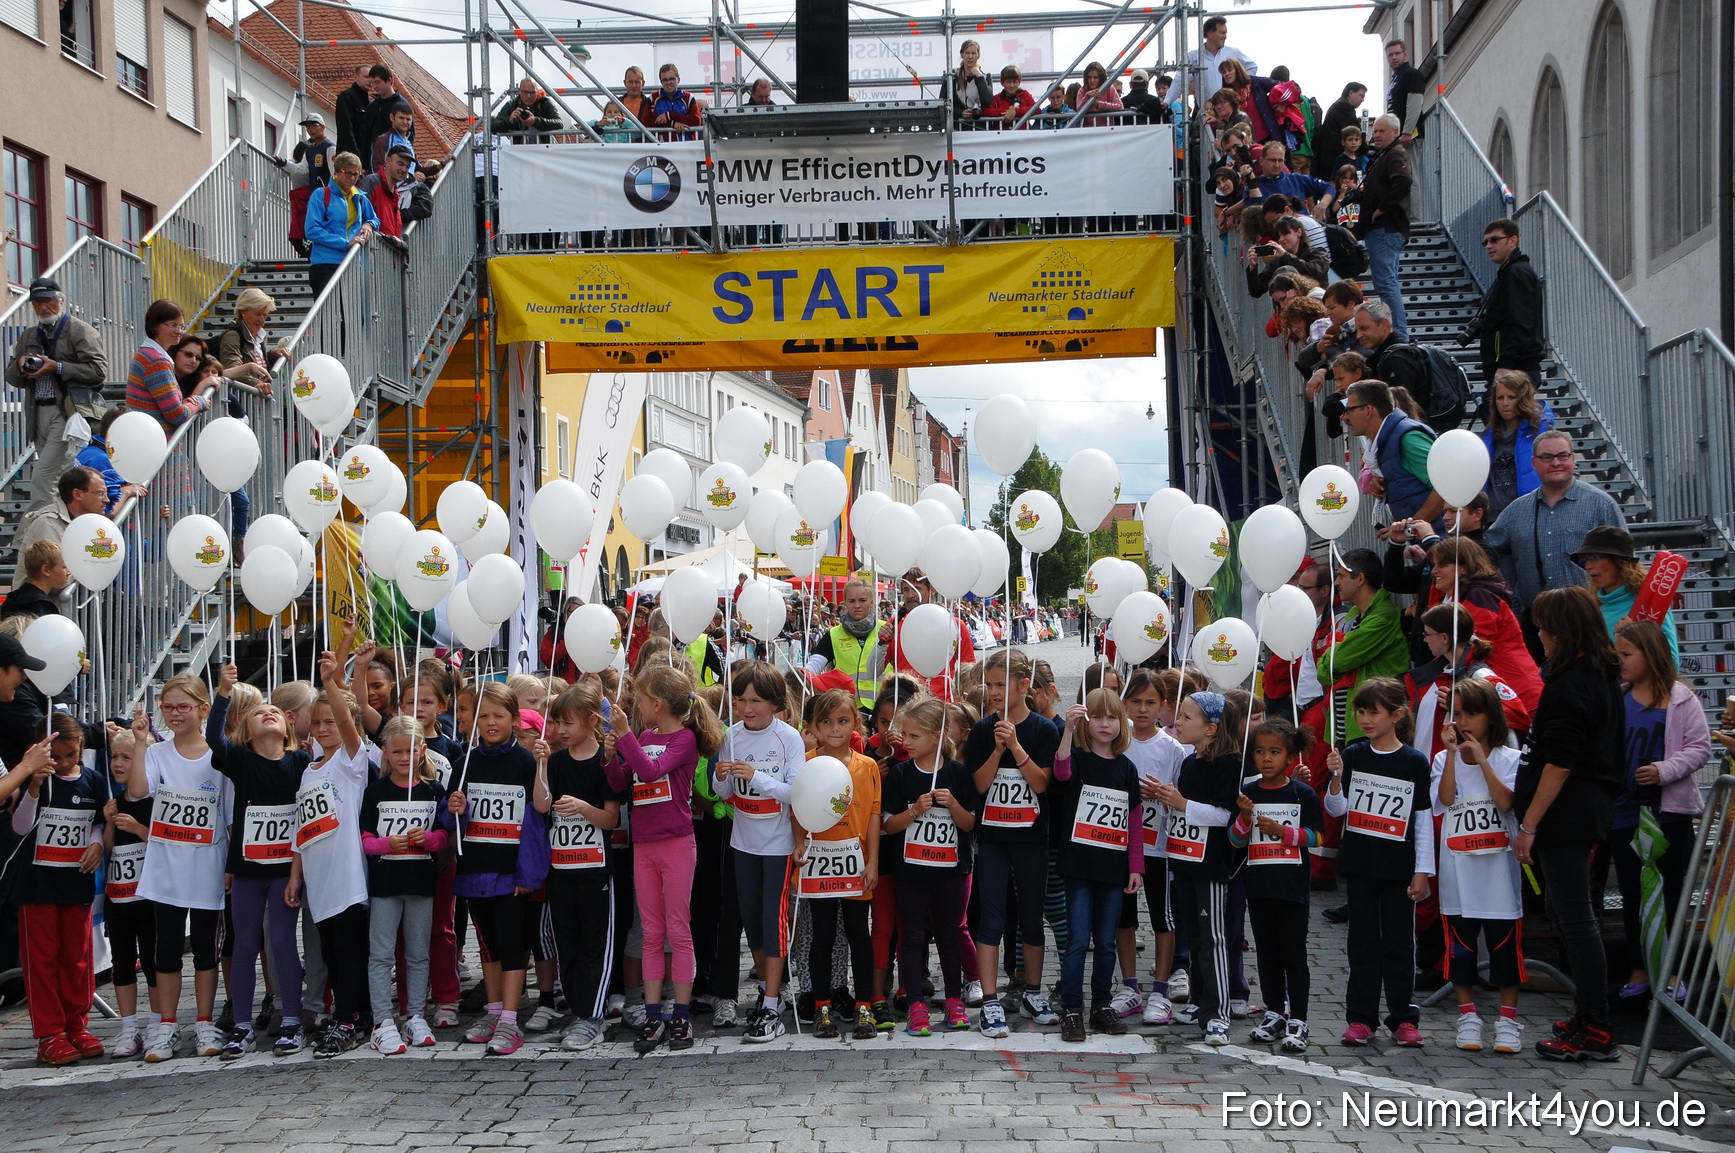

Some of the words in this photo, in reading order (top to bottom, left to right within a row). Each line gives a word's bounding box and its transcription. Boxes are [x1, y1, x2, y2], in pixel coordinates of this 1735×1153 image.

[629, 156, 677, 176] BMW
[696, 159, 773, 184] BMW
[782, 152, 1046, 182] EfficientDynamics
[697, 190, 775, 208] Weniger
[779, 186, 881, 203] Verbrauch.
[886, 184, 935, 200] Mehr
[940, 181, 1048, 199] Fahrfreude.
[712, 264, 944, 324] START
[988, 290, 1068, 303] Neumarkter
[1072, 288, 1135, 301] Stadtlauf
[526, 302, 605, 314] Neumarkter
[609, 301, 672, 313] Stadtlauf
[591, 446, 609, 499] BKK
[1125, 537, 1137, 545] lauf
[1351, 777, 1369, 786] PARTL
[1370, 781, 1403, 792] Neumarkt
[158, 789, 175, 798] PARTL
[175, 794, 207, 802] Neumarkt
[468, 788, 482, 796] PARTL
[484, 789, 514, 797] Neumarkt
[991, 782, 1033, 805] 7024
[1082, 790, 1103, 800] PARTL
[471, 797, 515, 821] 7031
[741, 799, 759, 811] Luca
[1354, 788, 1404, 818] 7172
[1448, 804, 1465, 812] PARTL
[41, 812, 63, 821] PARTL
[160, 800, 209, 827] 7288
[998, 810, 1021, 820] Lucia
[1086, 802, 1127, 829] 7258
[1257, 809, 1289, 817] Neumarkt
[1453, 807, 1501, 833] 7034
[1358, 815, 1388, 830] Leonie
[45, 823, 87, 847] 7331
[164, 827, 196, 840] Aurelia
[302, 825, 322, 839] Mona
[474, 825, 507, 836] Samina
[552, 824, 596, 846] 7022
[913, 819, 955, 844] 7032
[1091, 828, 1121, 842] Carolin
[821, 845, 853, 853] Neumarkt
[1465, 836, 1495, 849] Erjona
[557, 852, 589, 863] Tamina
[922, 848, 946, 860] Mona
[1254, 846, 1285, 858] Liliana
[807, 854, 858, 877] 7250
[819, 880, 845, 891] Alicia
